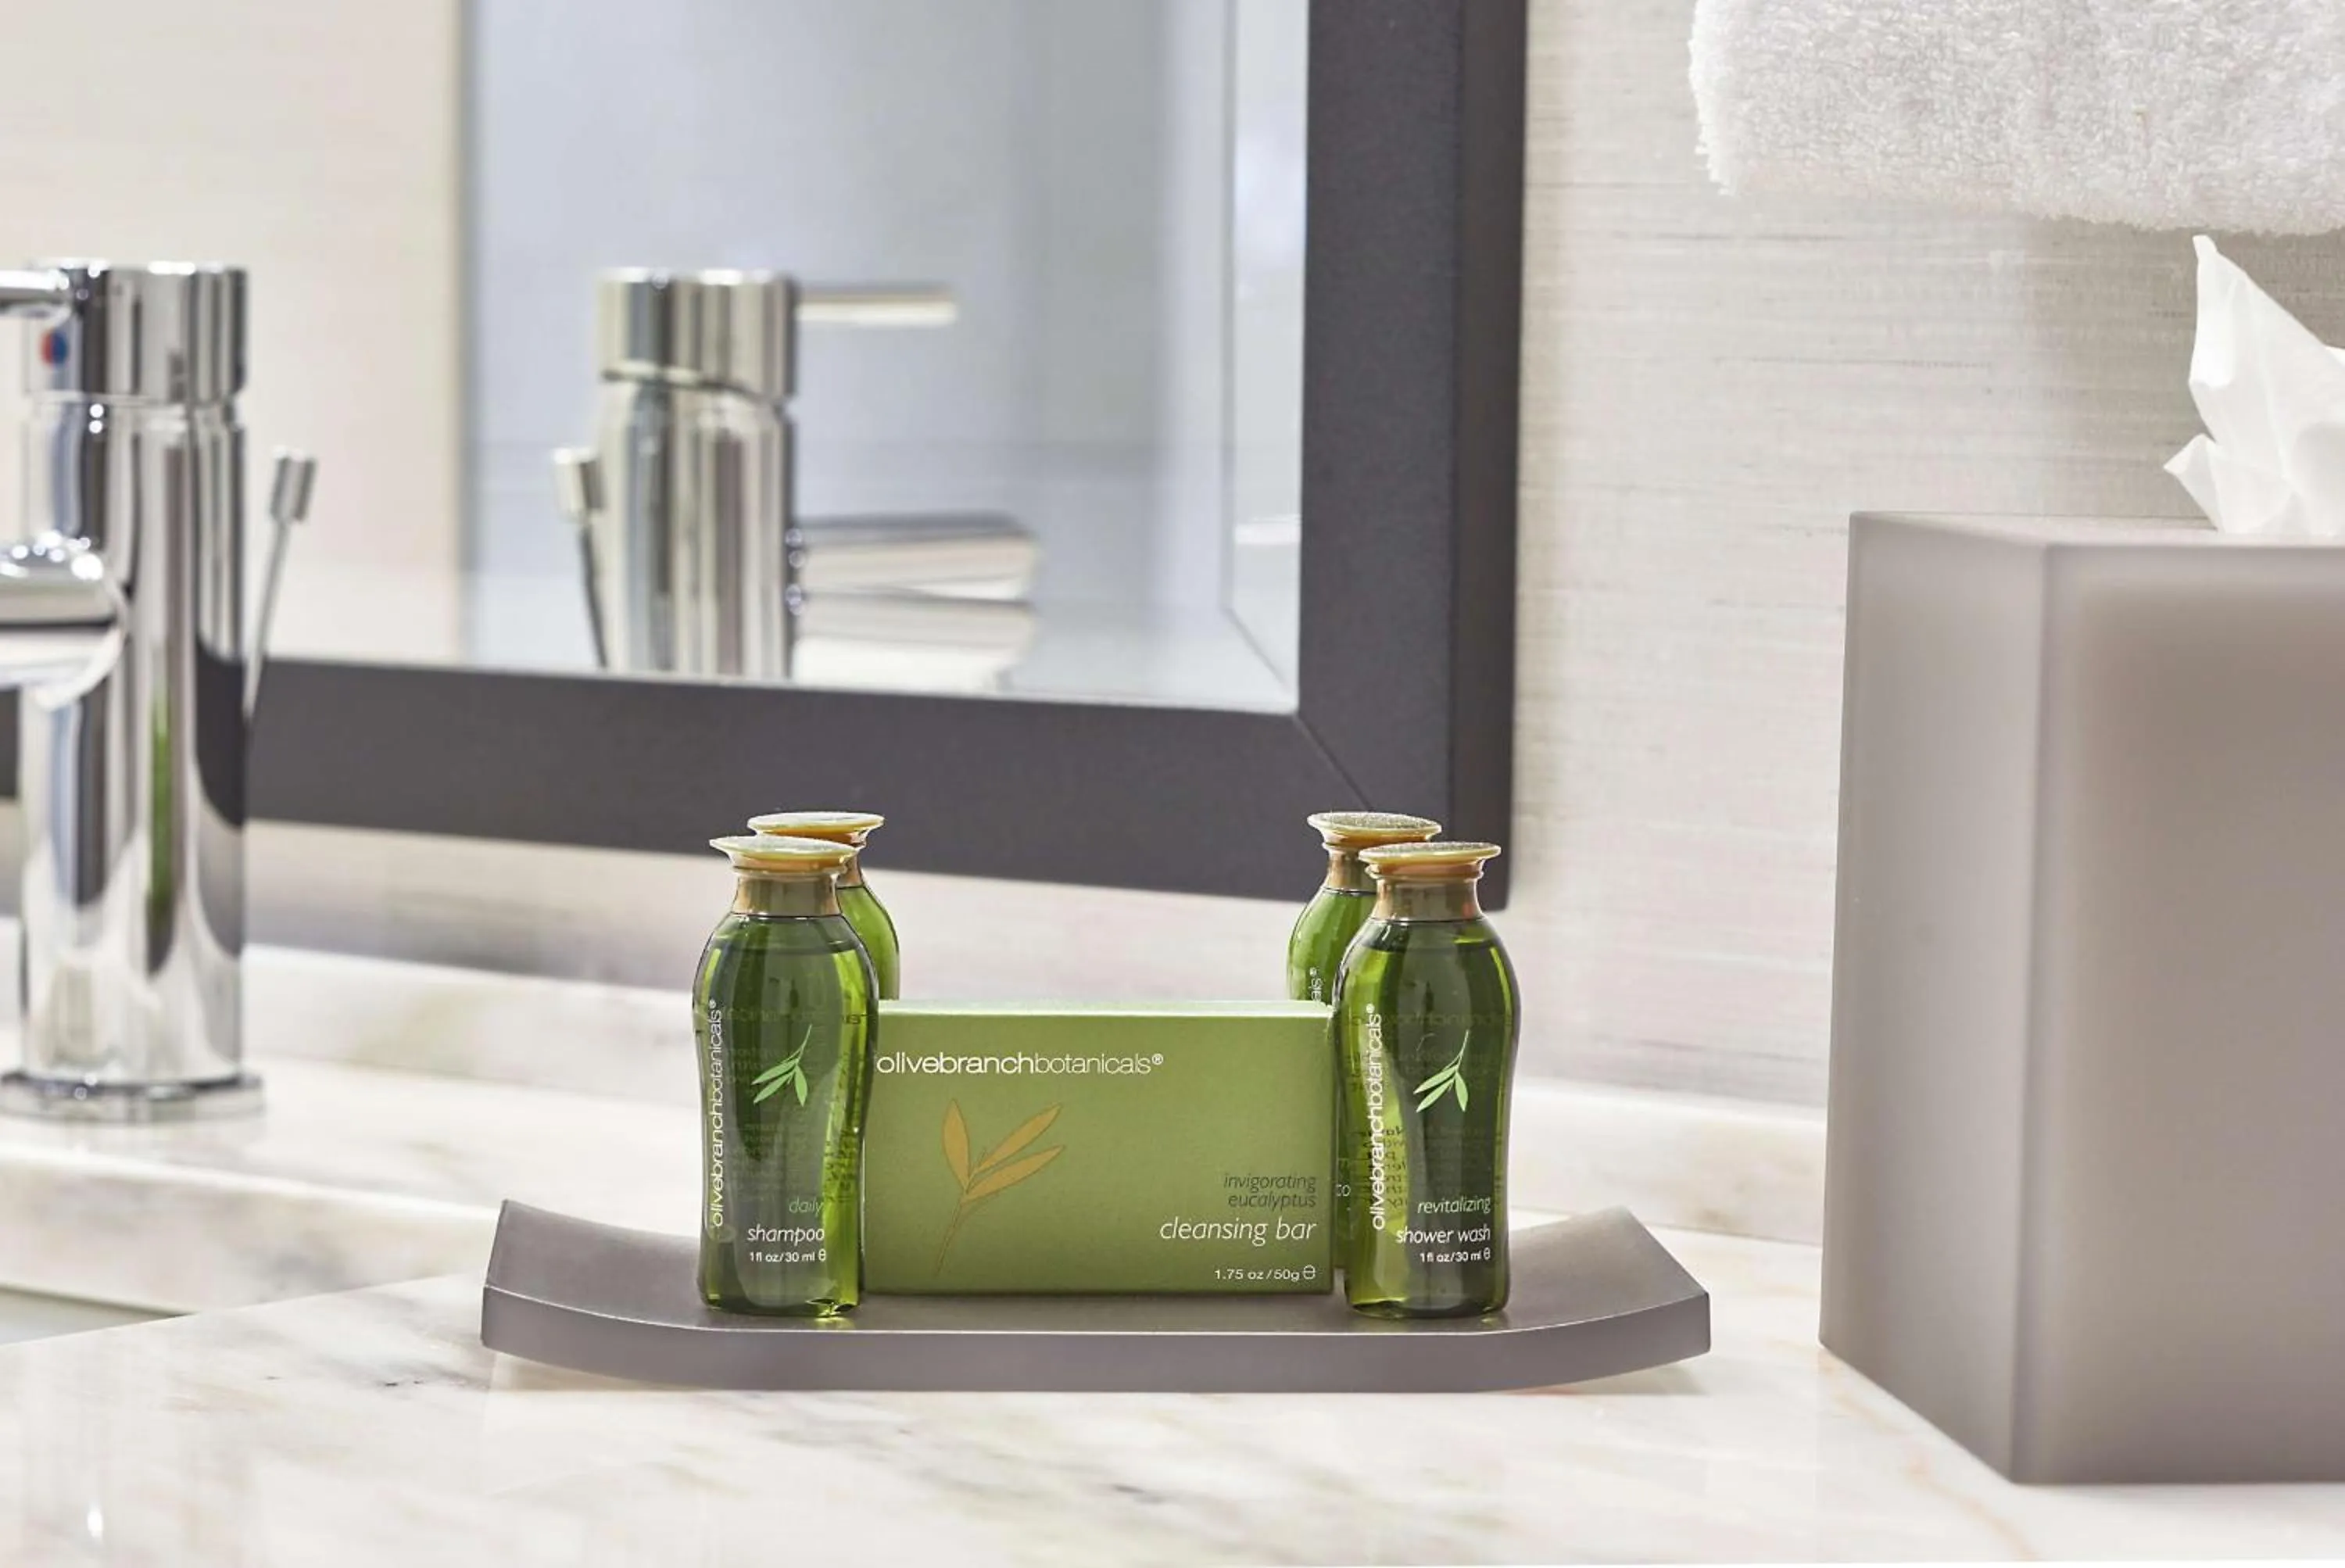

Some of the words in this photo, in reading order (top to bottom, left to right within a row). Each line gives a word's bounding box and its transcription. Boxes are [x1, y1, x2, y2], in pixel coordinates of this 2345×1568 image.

[1223, 1173, 1316, 1194] invigorating
[789, 1196, 825, 1218] daily
[1228, 1191, 1316, 1211] eucalyptus
[1417, 1195, 1491, 1214] revitalizing
[747, 1223, 825, 1247] shampoo
[1160, 1216, 1269, 1247] cleansing
[1276, 1215, 1317, 1240] bar
[1396, 1225, 1454, 1244] shower
[1458, 1223, 1491, 1243] wash
[801, 1251, 815, 1262] ml
[1215, 1269, 1244, 1280] 1.75
